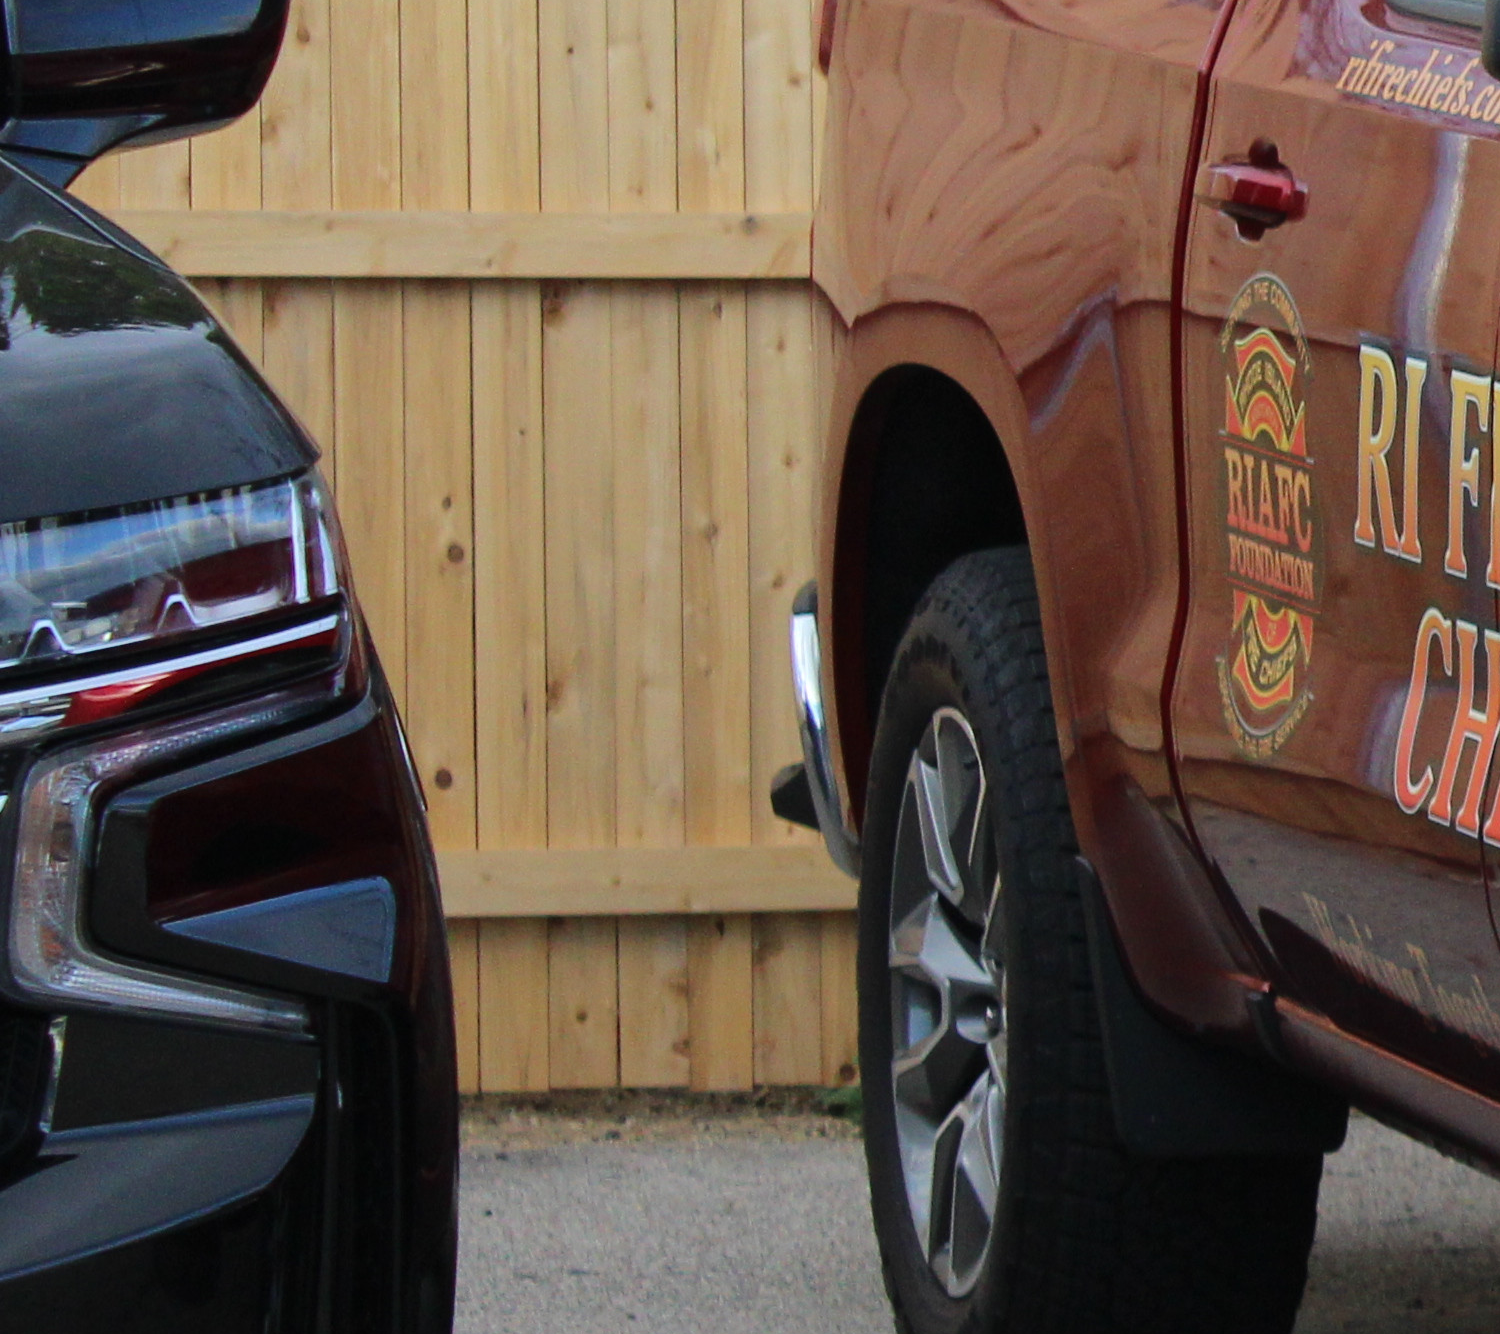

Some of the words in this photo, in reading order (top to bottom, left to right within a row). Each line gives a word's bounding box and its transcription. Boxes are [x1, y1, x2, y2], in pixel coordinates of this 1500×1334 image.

[1225, 447, 1313, 554] RIAFC
[1354, 343, 1428, 565] RI
[1228, 533, 1314, 601] FOUNDATION
